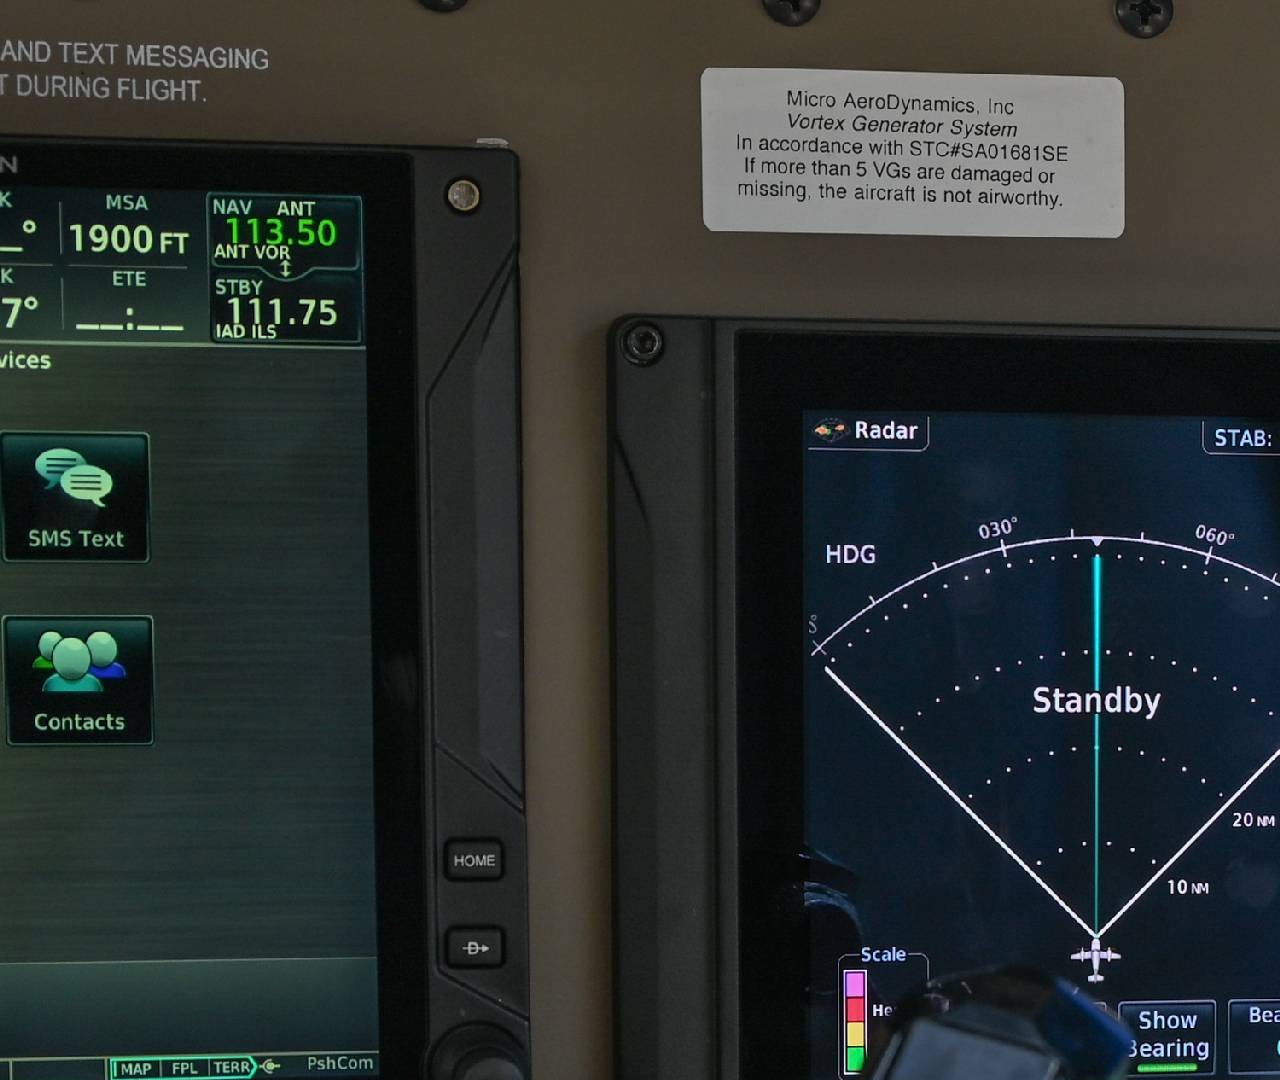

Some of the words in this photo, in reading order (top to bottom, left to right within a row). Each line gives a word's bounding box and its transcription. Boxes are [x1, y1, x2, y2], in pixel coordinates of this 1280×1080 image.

[1, 41, 51, 62] AND
[58, 43, 118, 65] TEXT
[127, 45, 269, 70] MESSAGING
[17, 76, 109, 98] DURING
[117, 79, 206, 102] FLIGHT.
[787, 90, 835, 107] Micro
[843, 94, 981, 115] AeroDynamics,
[988, 98, 1014, 114] Inc
[787, 114, 845, 131] Vortex
[852, 116, 942, 135] Generator
[950, 119, 1017, 138] System
[736, 134, 752, 150] In
[759, 137, 862, 155] accordance
[868, 140, 903, 156] with
[909, 142, 1068, 162] STC#SA01681SE
[744, 158, 758, 173] If
[761, 160, 806, 176] more
[811, 161, 850, 177] than
[856, 162, 866, 176] 5
[873, 162, 910, 179] VGs
[917, 165, 944, 180] are
[951, 165, 1032, 185] damaged
[1039, 169, 1055, 183] or
[106, 195, 148, 210] MSA
[737, 181, 811, 202] missing,
[819, 184, 846, 199] the
[854, 185, 915, 201] aircraft
[923, 187, 936, 202] is
[943, 188, 971, 203] not
[978, 189, 1063, 209] airworthy.
[213, 199, 252, 215] NAV
[277, 202, 315, 217] ANT
[69, 223, 153, 254] 1900
[160, 233, 188, 254] FT
[226, 218, 337, 246] 113.50
[113, 271, 146, 286] ETE
[215, 279, 263, 295] STBY
[226, 298, 338, 325] 111.75
[855, 421, 918, 440] Radar
[1215, 428, 1272, 447] STAB:
[29, 530, 71, 548] SMS
[78, 530, 124, 548] Text
[826, 545, 876, 565] HDG
[1033, 687, 1161, 720] Standby
[34, 713, 125, 732] Contacts
[454, 855, 495, 866] HOME
[861, 947, 906, 963] Scale
[1139, 1011, 1197, 1029] Show
[121, 1062, 151, 1076] MAP
[172, 1062, 197, 1075] FPL
[213, 1061, 250, 1074] TERR
[308, 1055, 373, 1071] PshCom
